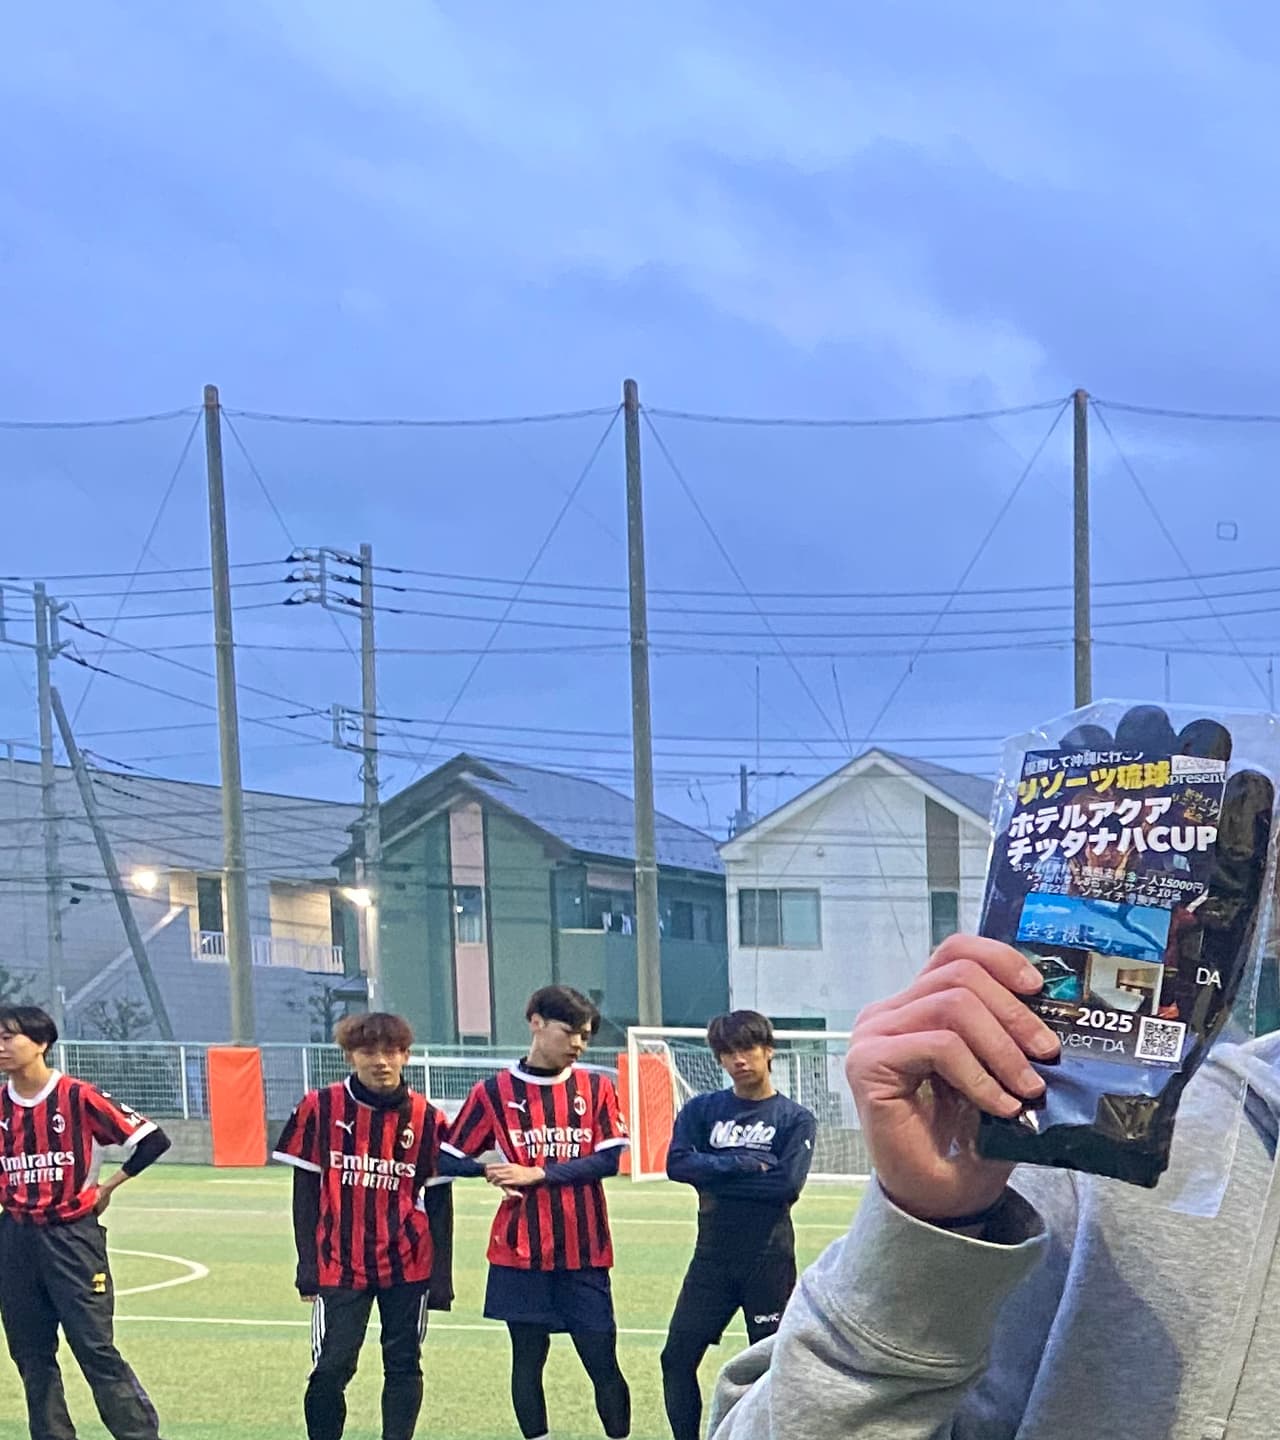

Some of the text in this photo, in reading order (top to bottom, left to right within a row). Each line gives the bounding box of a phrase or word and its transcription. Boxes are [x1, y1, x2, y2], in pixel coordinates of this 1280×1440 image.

[1008, 797, 1172, 837] ホテルアクア
[1007, 826, 1218, 866] チッタナハCUP
[1076, 1008, 1133, 1032] 2025
[509, 1124, 593, 1147] Emirates
[543, 1143, 579, 1159] BETTER
[24, 1168, 63, 1183] BETTER
[330, 1150, 416, 1178] Emirates
[342, 1170, 400, 1191] FLY BETTER
